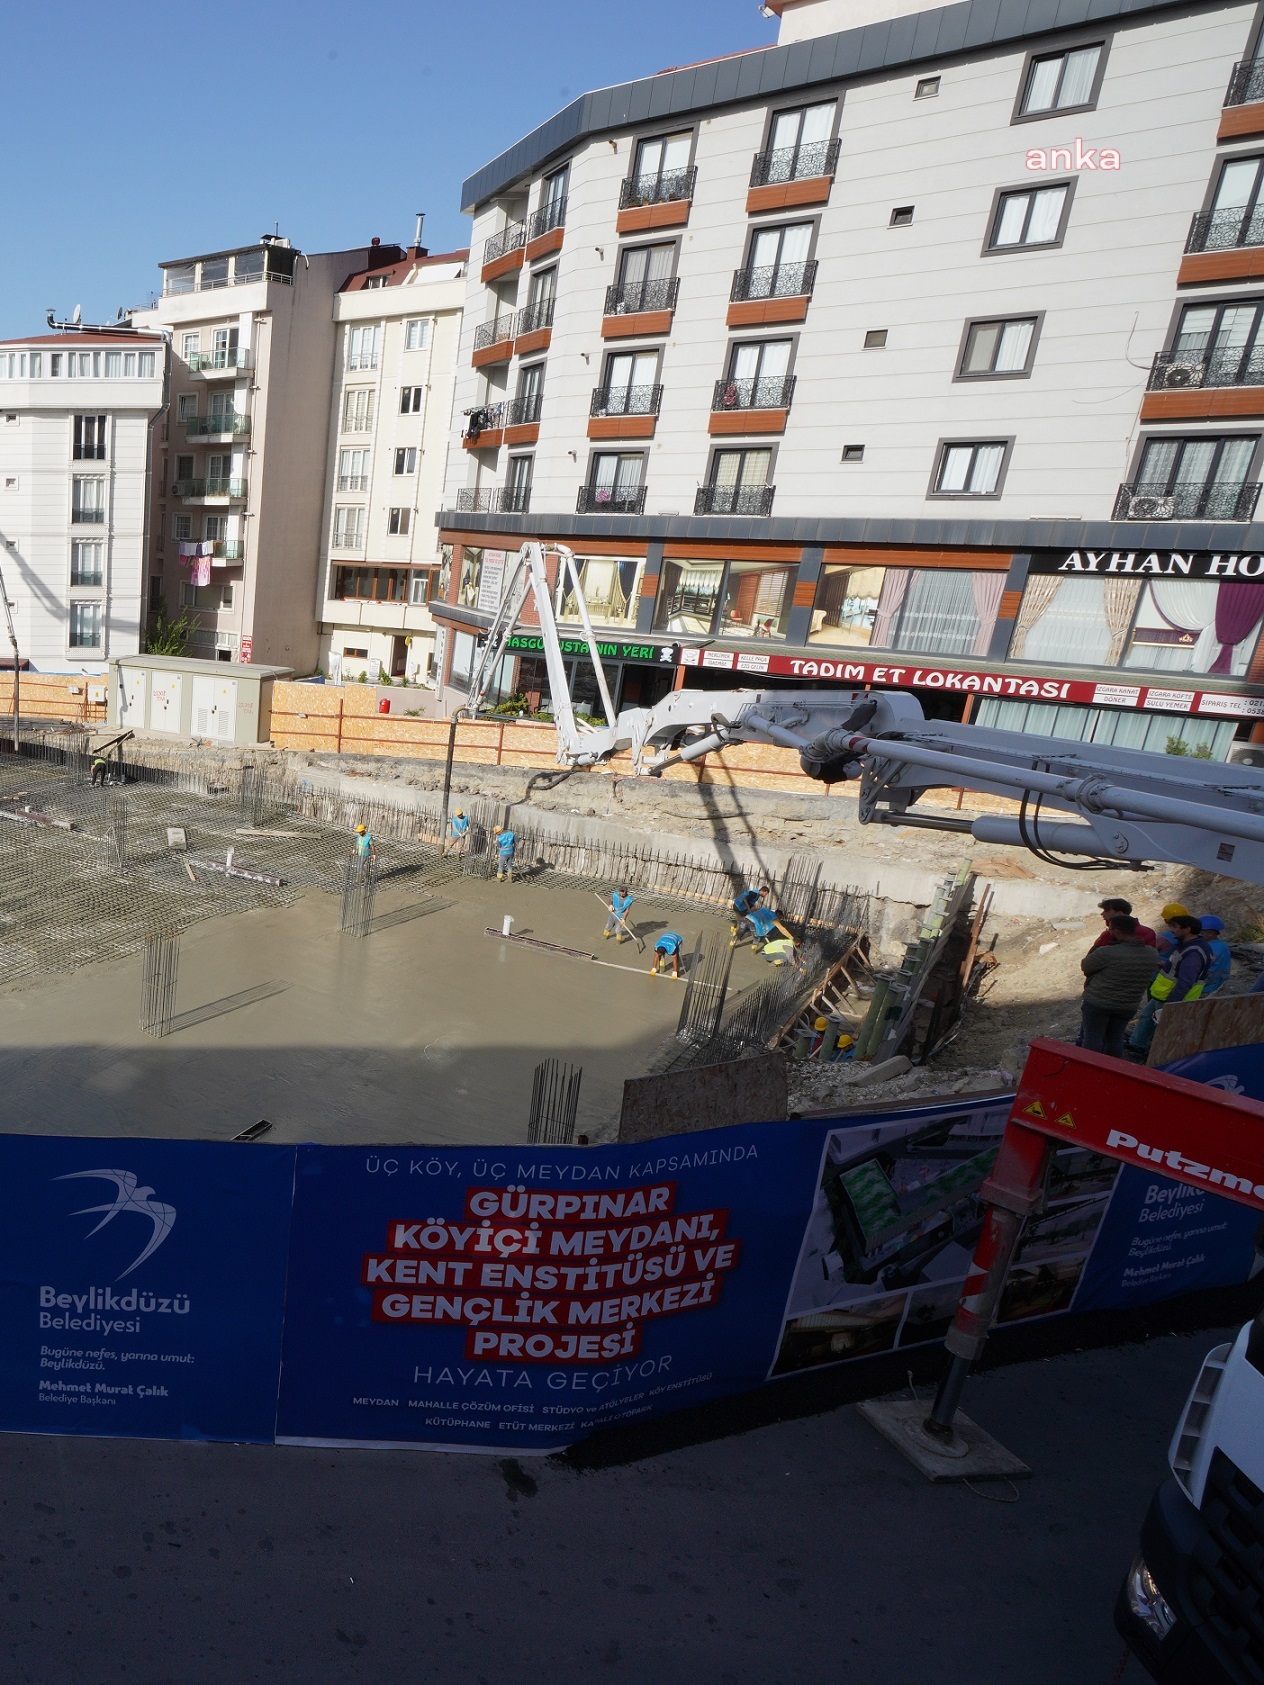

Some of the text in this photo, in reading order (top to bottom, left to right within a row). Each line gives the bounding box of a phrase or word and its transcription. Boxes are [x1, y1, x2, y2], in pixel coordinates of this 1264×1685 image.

[1058, 550, 1198, 574] AYHAN
[507, 637, 544, 650] ASGÜ
[623, 645, 655, 660] YERİ
[790, 659, 1071, 699] TADIM ET LOKANTASI
[365, 1143, 759, 1181] ÜÇ KÖY, ÜÇ MEYDAN KAPSAMINDA
[469, 1183, 671, 1221] GÜRPINAR
[1144, 1183, 1206, 1205] Beylik
[1138, 1198, 1206, 1223] Belediyesi
[393, 1213, 720, 1259] KÖYİÇİ MEYDANI,
[366, 1241, 736, 1291] KENT ENSTİTÜSÜ VE
[39, 1285, 191, 1314] Beylikdüzü
[381, 1271, 717, 1326] GENÇLİK MERKEZİ
[39, 1311, 141, 1336] Belediyesi
[472, 1322, 637, 1359] PROJESİ
[39, 1357, 106, 1371] Beylikdüzü.
[40, 1345, 196, 1364] Bugüne nefes, yarına umut:
[413, 1355, 674, 1394] HAYATA GEÇİYOR
[39, 1380, 169, 1398] Mehmet Murat Çalık
[39, 1392, 117, 1407] Belediye Başkanı
[352, 1396, 400, 1407] MEYDAN
[408, 1399, 459, 1411] MAHALLE
[461, 1400, 502, 1414] ÇÖZÜM
[502, 1403, 535, 1415] OFİSİ
[542, 1403, 585, 1415] STÜDYO
[598, 1391, 645, 1412] ATÖLYELER
[648, 1384, 666, 1397] KÖY
[425, 1416, 491, 1429] KÜTÜPHANE
[499, 1419, 528, 1431] ETÜT
[528, 1420, 576, 1433] MERKEZİ
